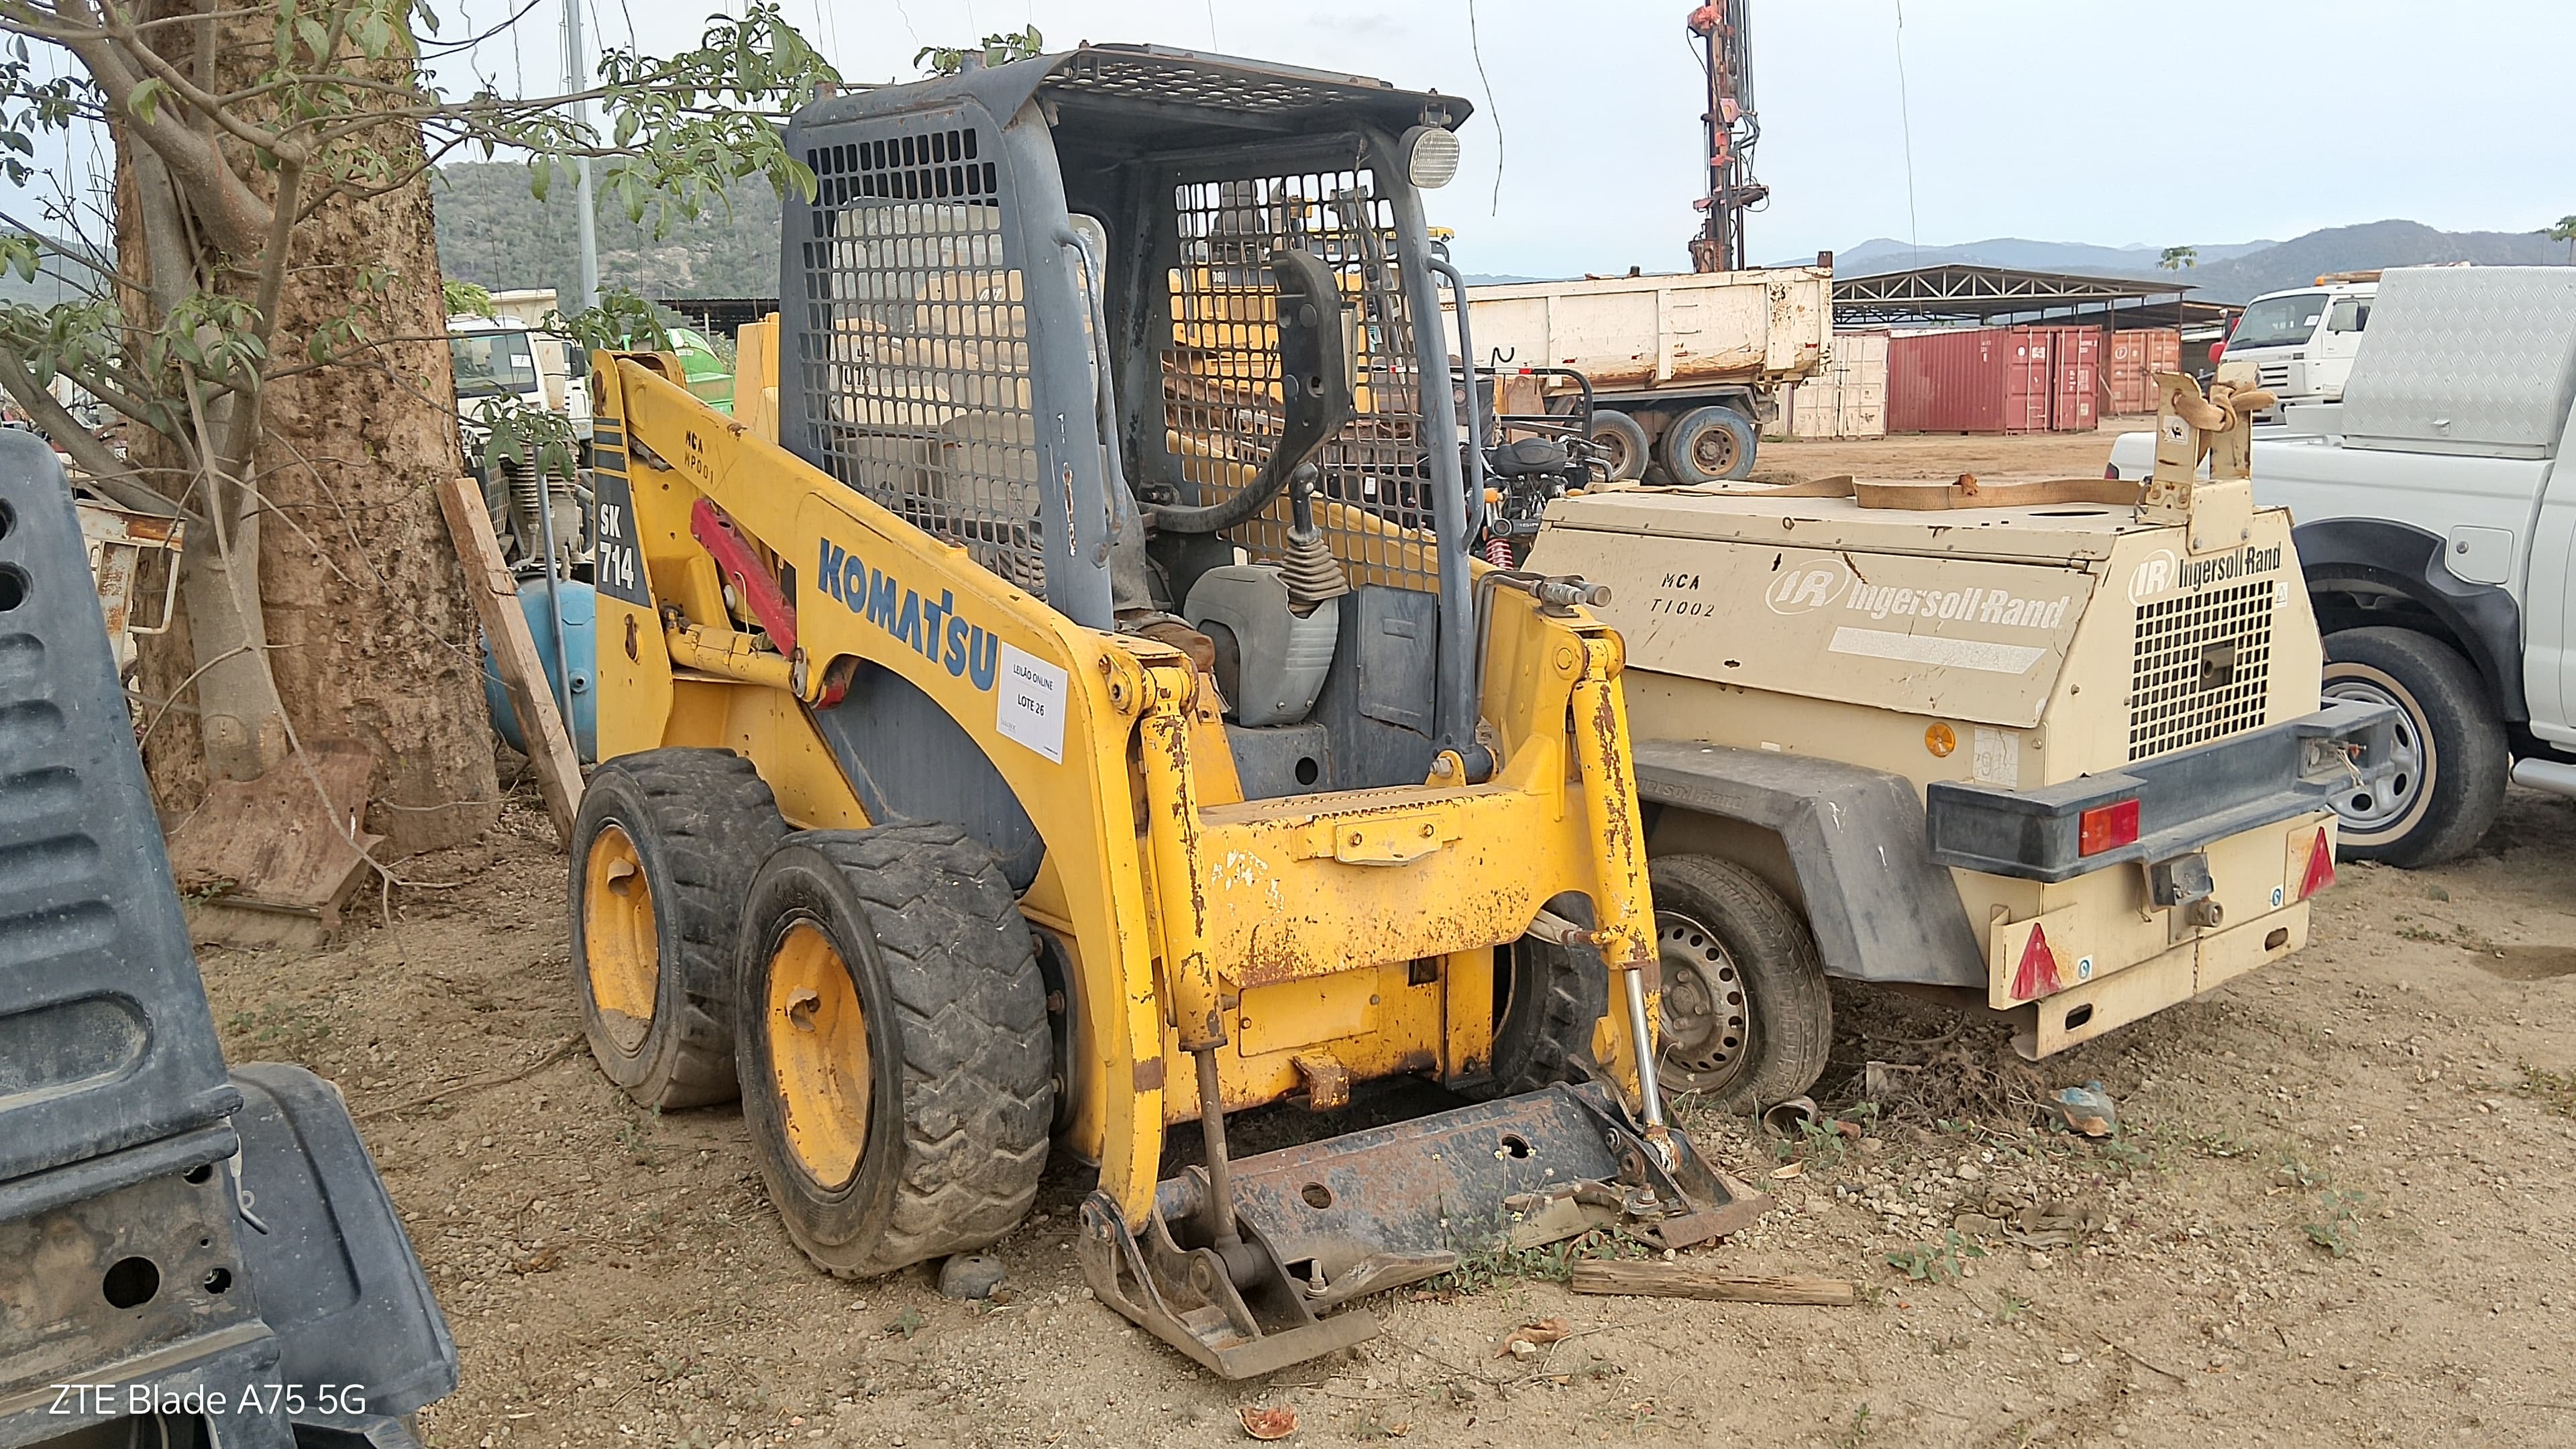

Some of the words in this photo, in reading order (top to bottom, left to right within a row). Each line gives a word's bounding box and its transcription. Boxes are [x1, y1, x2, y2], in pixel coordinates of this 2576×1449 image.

[686, 430, 704, 454] MCA
[600, 503, 621, 538] SK
[599, 541, 634, 590] 714
[2135, 559, 2167, 596] IR
[2179, 541, 2282, 592] Ingersoll-Rand
[1662, 573, 1699, 590] MCA
[818, 537, 998, 691] KOMATSU
[1651, 599, 1715, 617] T1002
[1775, 570, 1834, 606] IR
[1845, 579, 2070, 629] Ingersoll-Rand
[1013, 663, 1031, 680] LEILÃO
[1032, 674, 1053, 691] ONLINE
[1018, 693, 1034, 712] LOTE
[1035, 702, 1044, 716] 26
